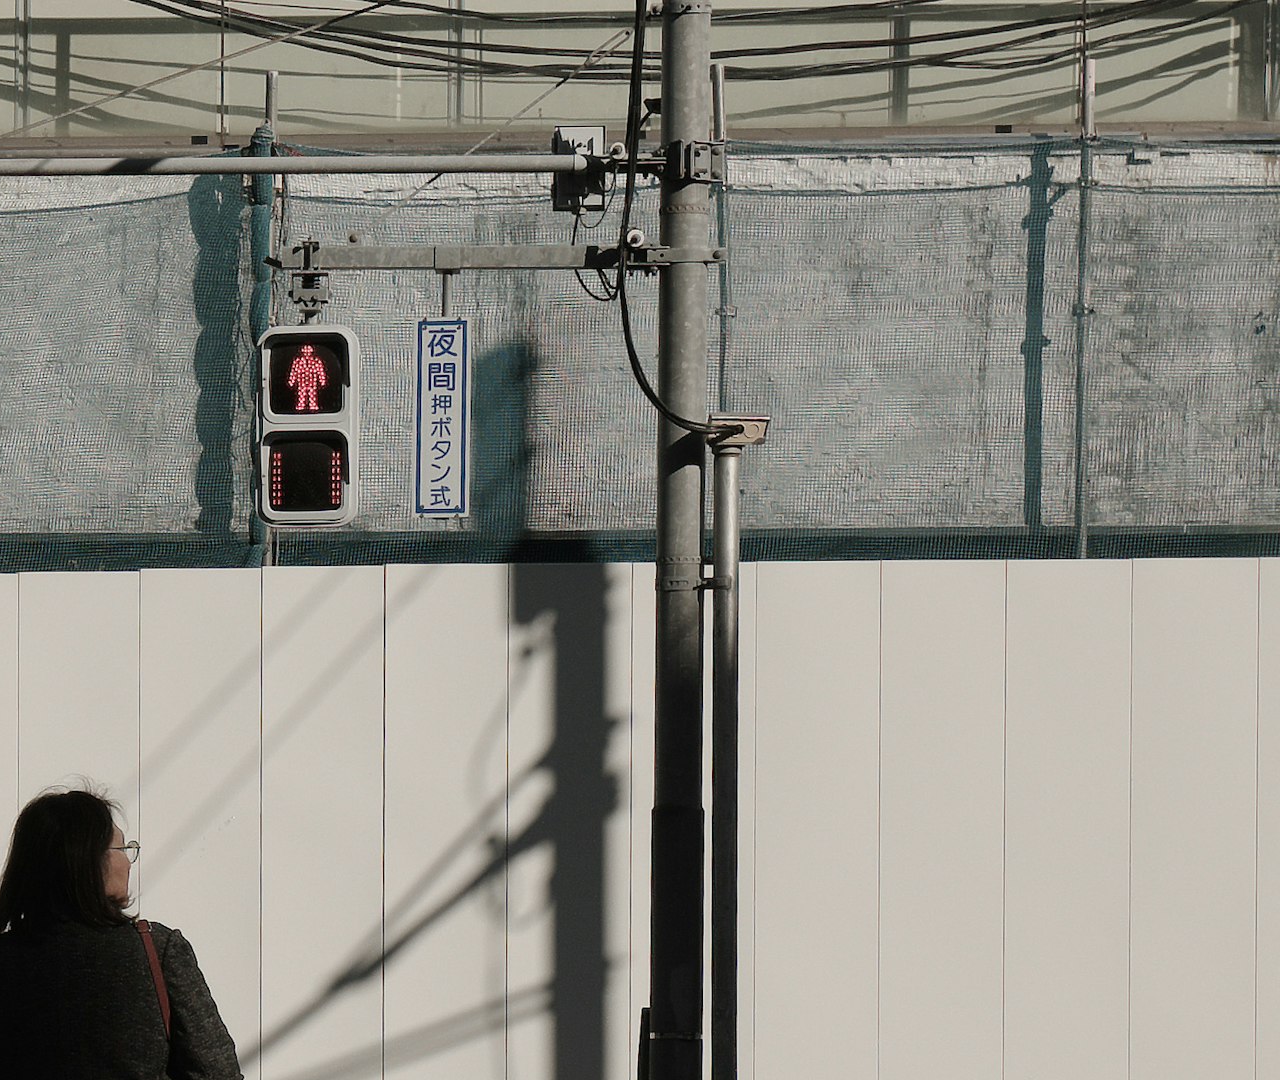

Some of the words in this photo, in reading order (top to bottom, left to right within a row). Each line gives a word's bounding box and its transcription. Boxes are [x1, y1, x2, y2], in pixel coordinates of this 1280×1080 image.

[427, 327, 458, 507] 夜間押ボタン式
